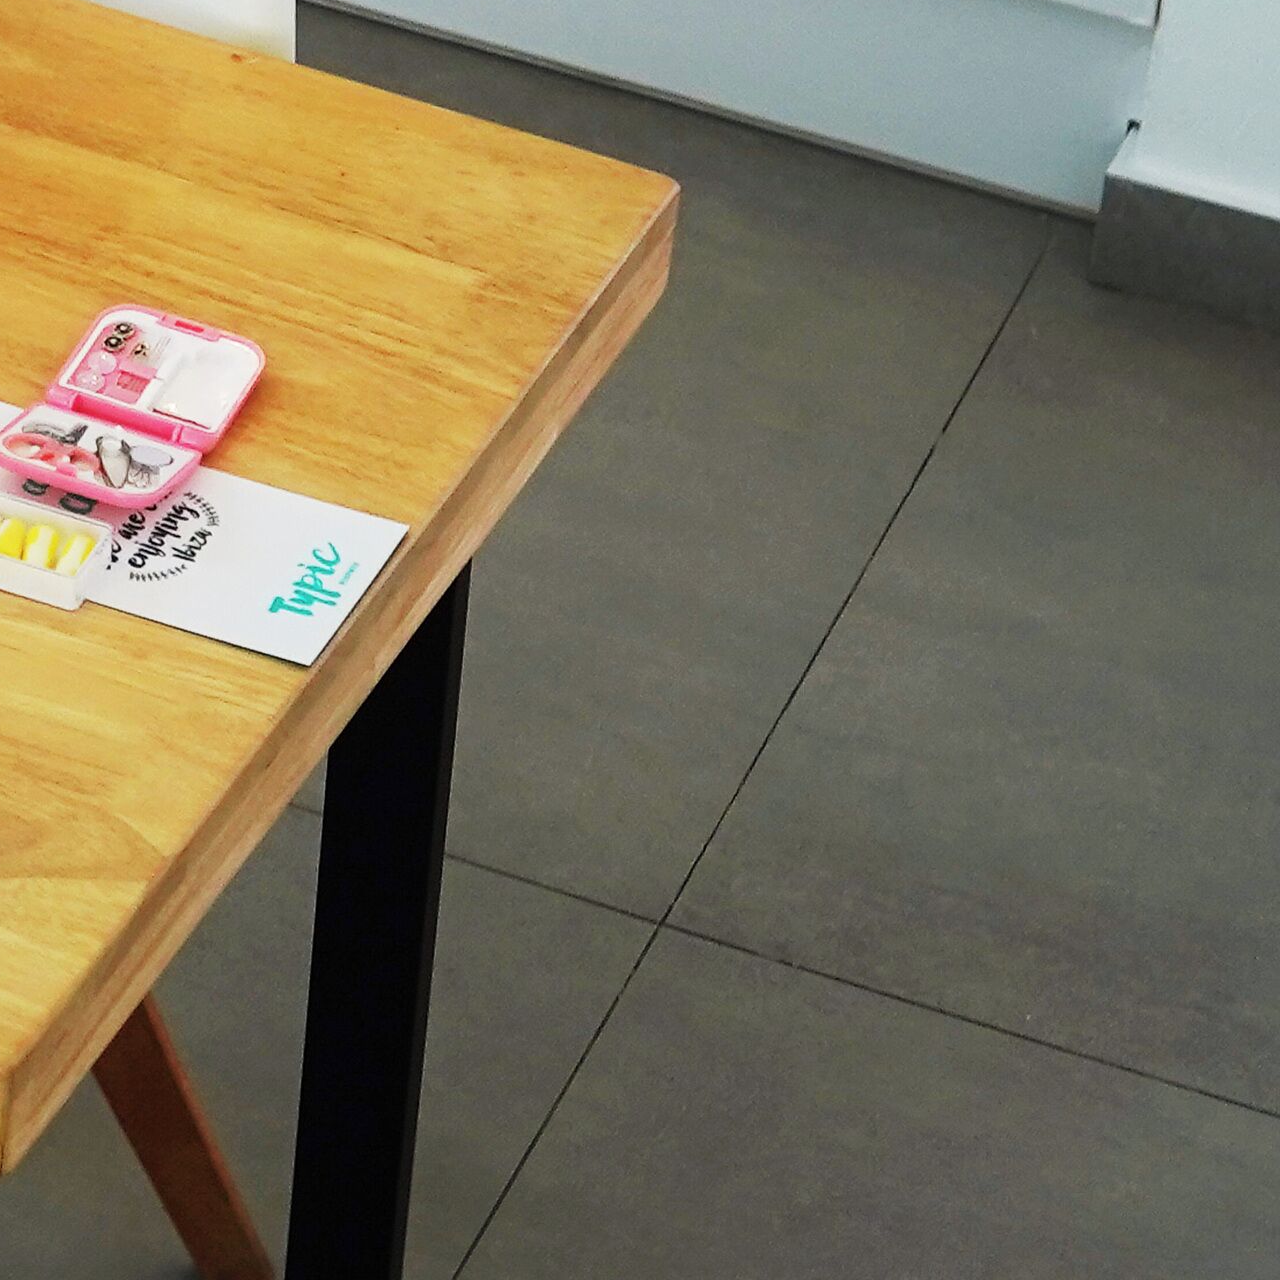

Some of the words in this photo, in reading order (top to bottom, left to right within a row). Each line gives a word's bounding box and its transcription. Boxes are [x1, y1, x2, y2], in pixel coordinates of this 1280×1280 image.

[127, 500, 202, 570] enjoying
[171, 527, 214, 563] Ibiza
[268, 541, 342, 616] Typic
